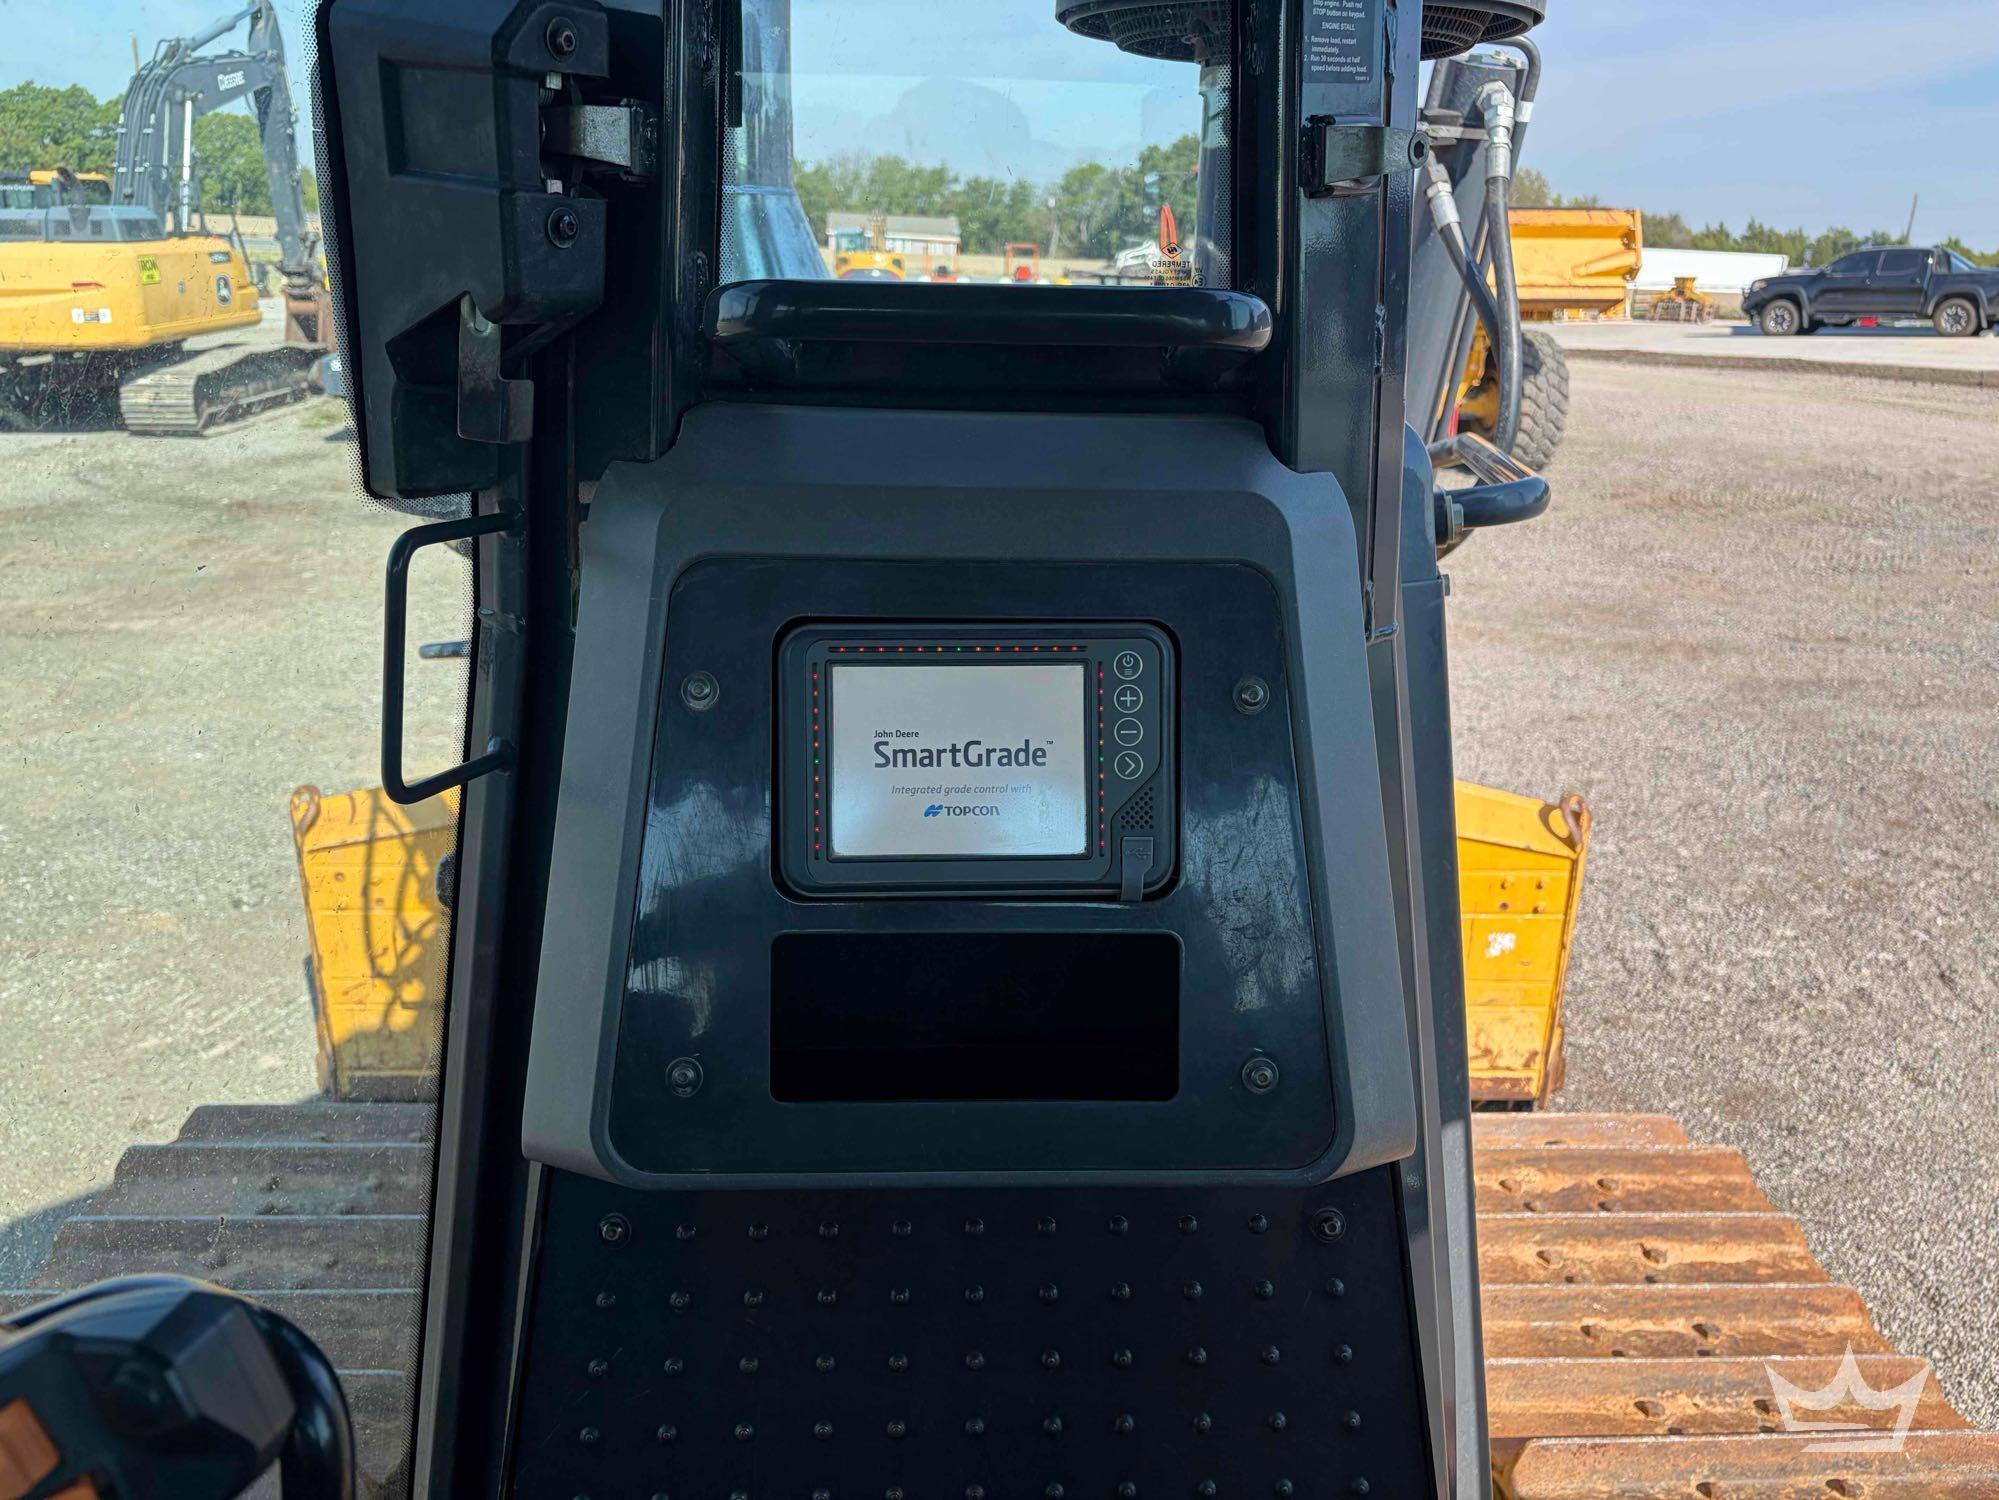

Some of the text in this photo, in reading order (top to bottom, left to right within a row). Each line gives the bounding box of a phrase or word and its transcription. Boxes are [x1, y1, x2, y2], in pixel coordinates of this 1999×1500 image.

[1322, 22, 1355, 31] ENGINE STALL
[1342, 37, 1356, 45] restart
[1311, 64, 1325, 73] speed
[1326, 64, 1340, 72] before
[1341, 65, 1355, 73] adding
[874, 730, 919, 738] John Deere
[891, 784, 1032, 797] Integrated grade control with
[944, 805, 1000, 817] TOPCON
